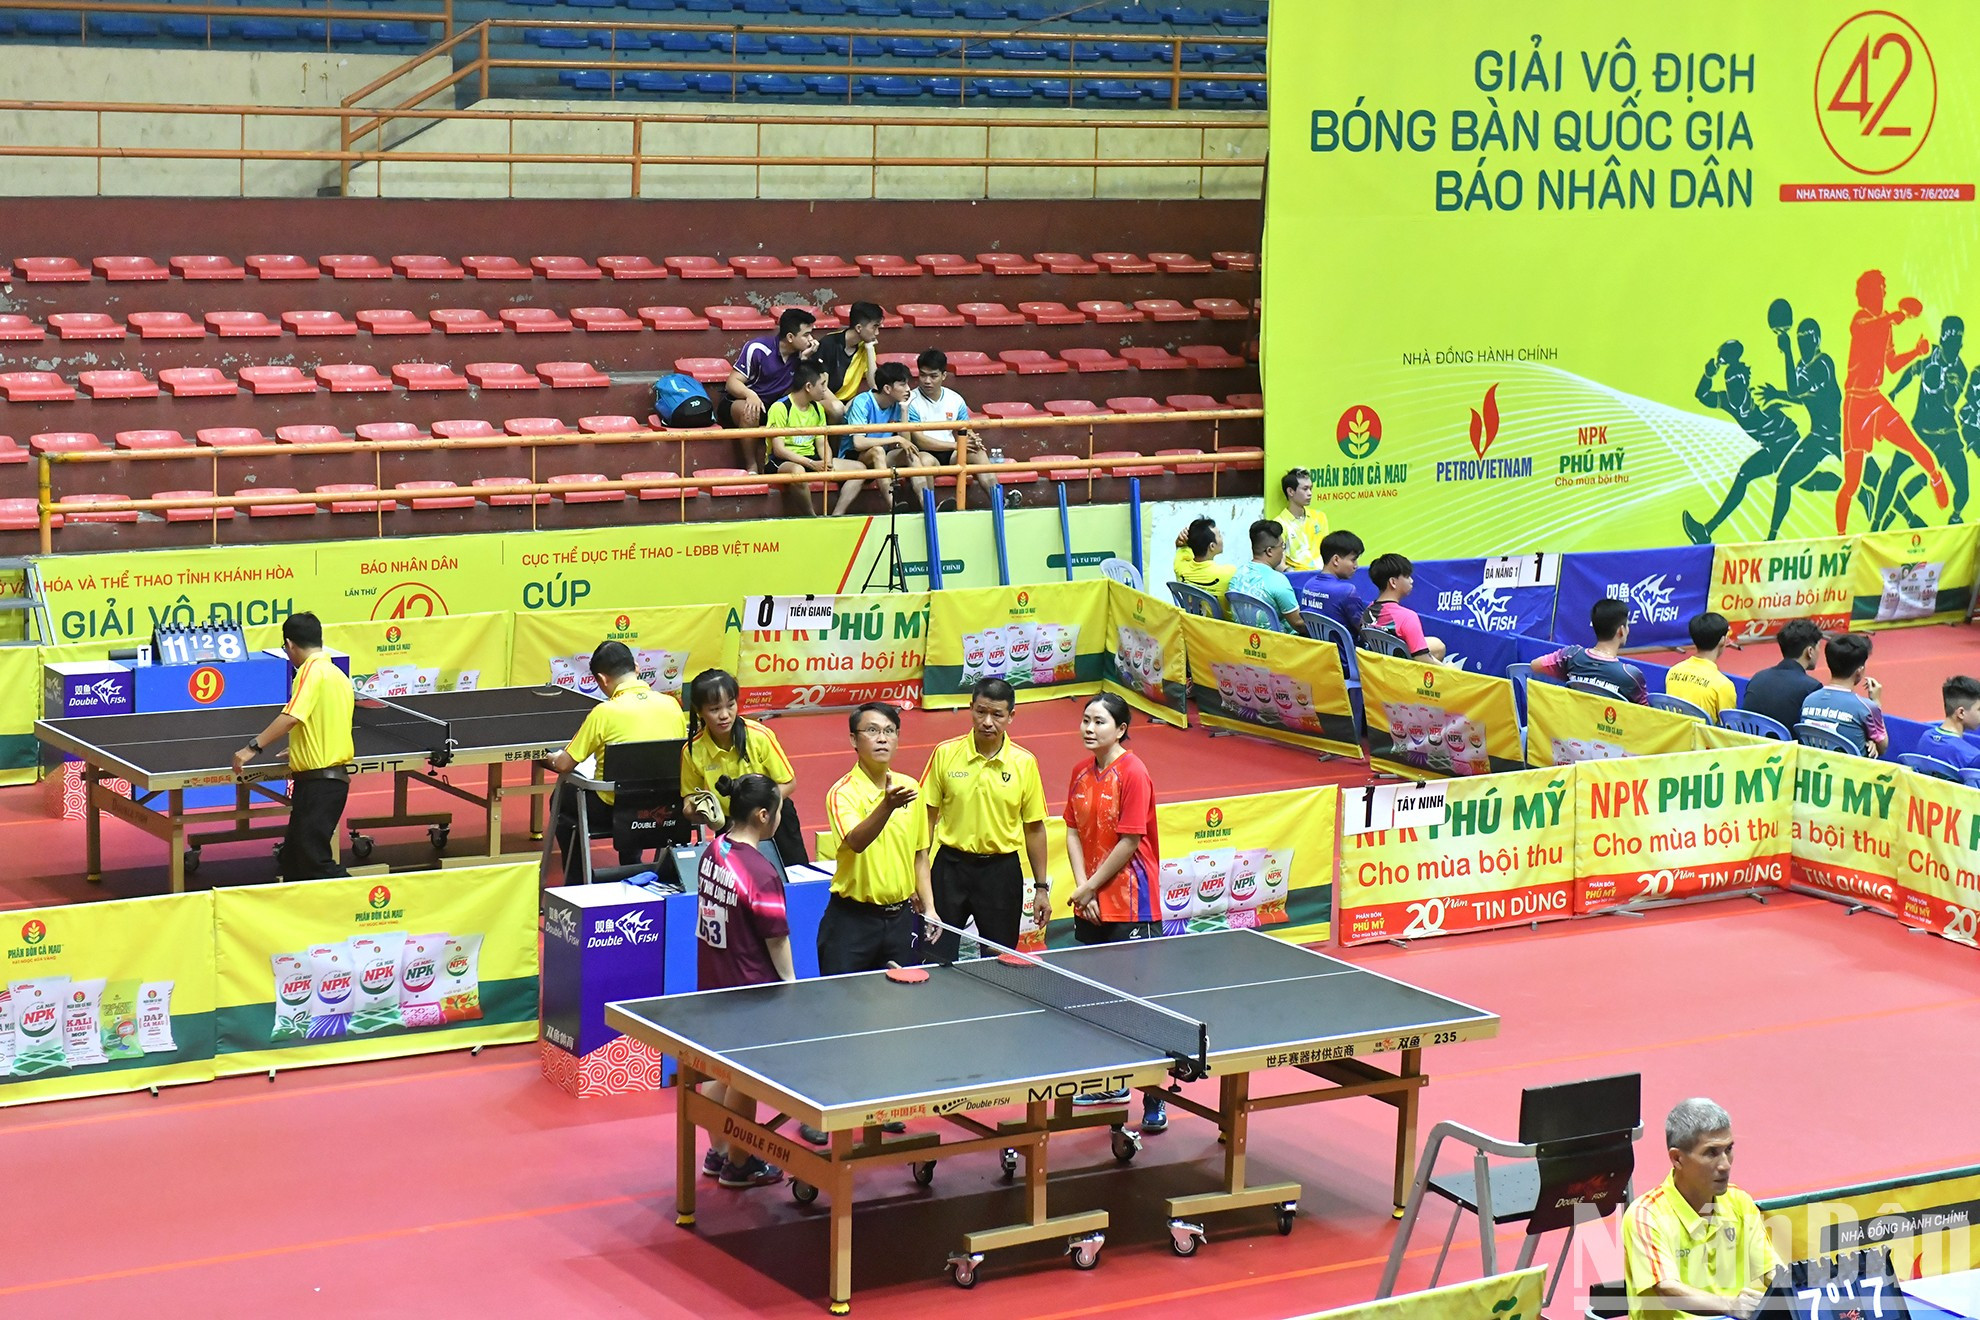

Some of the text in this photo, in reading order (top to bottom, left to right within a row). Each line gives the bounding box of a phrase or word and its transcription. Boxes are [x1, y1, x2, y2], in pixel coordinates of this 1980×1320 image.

[1474, 33, 1755, 104] GIẢI VÔ ĐỊCH
[1826, 32, 1913, 136] 42
[1310, 88, 1754, 152] BÓNG BÀN QUỐC GIA
[1435, 153, 1753, 211] BÁO NHÂN DÂN
[1795, 187, 1817, 200] NHA
[1817, 187, 1851, 201] TRANG,
[1853, 185, 1868, 200] TỪ
[1868, 185, 1893, 200] NGÀY
[1893, 187, 1913, 200] 31/5
[1920, 187, 1960, 200] 7/6/2024
[1402, 342, 1559, 366] NHÀ ĐỒNG HÀNH CHÍNH
[1577, 425, 1608, 446] NPK
[1436, 456, 1532, 482] PETROVIETNAM
[1559, 446, 1626, 474] PHÚ MỸ
[1309, 461, 1408, 488] PHÂN BÓN CÀ MAU
[1317, 488, 1398, 502] HẠT NGỌC MÙA VÀNG
[360, 555, 458, 575] BÁO NHÂN DÂN
[522, 553, 549, 568] CỤC
[553, 546, 578, 563] THỂ
[581, 550, 608, 565] DỤC
[611, 543, 637, 560] THỂ
[640, 546, 673, 559] THAO
[685, 544, 719, 557] LĐBB
[722, 540, 750, 558] VIỆT
[753, 542, 780, 553] NAM
[1722, 544, 1852, 585] NPK PHÚ MỸ
[44, 576, 73, 593] HÓA
[77, 574, 97, 591] VÀ
[101, 570, 129, 589] THỂ
[133, 573, 173, 588] THAO
[177, 568, 210, 585] TỈNH
[214, 567, 263, 584] KHÁNH
[265, 564, 294, 580] HÒA
[1485, 565, 1498, 580] ĐÀ
[1515, 565, 1519, 578] 1
[360, 586, 378, 597] THỨ
[522, 572, 591, 610] CÚP
[1721, 588, 1847, 611] Cho mùa bội thu
[61, 597, 134, 639] GIẢI
[148, 594, 195, 629] VÔ
[757, 597, 775, 627] 0
[789, 602, 807, 617] TIẾN
[808, 606, 832, 617] GIANG
[1489, 615, 1517, 631] FISH
[1653, 606, 1678, 623] FISH
[162, 635, 189, 663] 11
[189, 634, 214, 650] 1 2
[217, 633, 241, 658] 8
[1011, 643, 1030, 654] NPK
[1036, 643, 1053, 654] NPK
[195, 671, 217, 700] 9
[556, 675, 575, 686] NPK
[68, 696, 99, 708] Double
[1590, 755, 1785, 820] NPK PHÚ MỸ
[1361, 787, 1444, 828] 1 TÂY NINH
[1512, 779, 1567, 831] MỸ
[631, 821, 656, 830] DOUBLE
[1907, 795, 1962, 847] NPK
[1592, 832, 1642, 858] Cho
[1649, 826, 1696, 853] mùa
[1703, 821, 1740, 849] bội
[1747, 817, 1780, 840] thu
[1809, 820, 1845, 851] bội
[1853, 830, 1891, 859] thu
[1267, 871, 1282, 880] NPK
[1358, 844, 1563, 888] Cho mùa bội thu
[1908, 849, 1950, 882] Cho
[1166, 886, 1191, 900] NPK
[1200, 876, 1225, 892] NPK
[1233, 875, 1256, 891] NPK
[1628, 869, 1675, 903] 20
[1698, 871, 1728, 890] TIN
[1732, 862, 1782, 886] DÙNG
[1801, 866, 1893, 903] TIN DÙNG
[1352, 917, 1385, 932] PHÚ MỸ
[1403, 890, 1568, 936] 20 Năm TIN DÙNG
[545, 921, 563, 938] Double
[1942, 905, 1978, 947] 20
[586, 932, 659, 949] Double FISH
[363, 966, 394, 983] NPK
[406, 966, 435, 982] NPK
[449, 959, 468, 969] NPK
[282, 981, 312, 994] NPK
[321, 976, 352, 991] NPK
[23, 1008, 56, 1025] NPK
[66, 1019, 92, 1028] KALI
[143, 1014, 164, 1022] DAP
[1397, 1035, 1421, 1050] 双鱼
[1433, 1031, 1457, 1045] 235
[1266, 1044, 1355, 1068] 世乒赛器材供应商
[1027, 1073, 1134, 1102] MOFIT
[966, 1096, 1010, 1112] Double FISH
[724, 1116, 791, 1163] DOUBLE FISH
[1555, 1191, 1608, 1209] DOUBLE FISH
[1840, 1210, 1969, 1243] NHÀ ĐỒNG HÀNH CHÍNH
[1797, 1287, 1823, 1320] 7
[1826, 1282, 1840, 1304] 0
[1843, 1278, 1855, 1300] 1
[1860, 1276, 1884, 1318] 7
